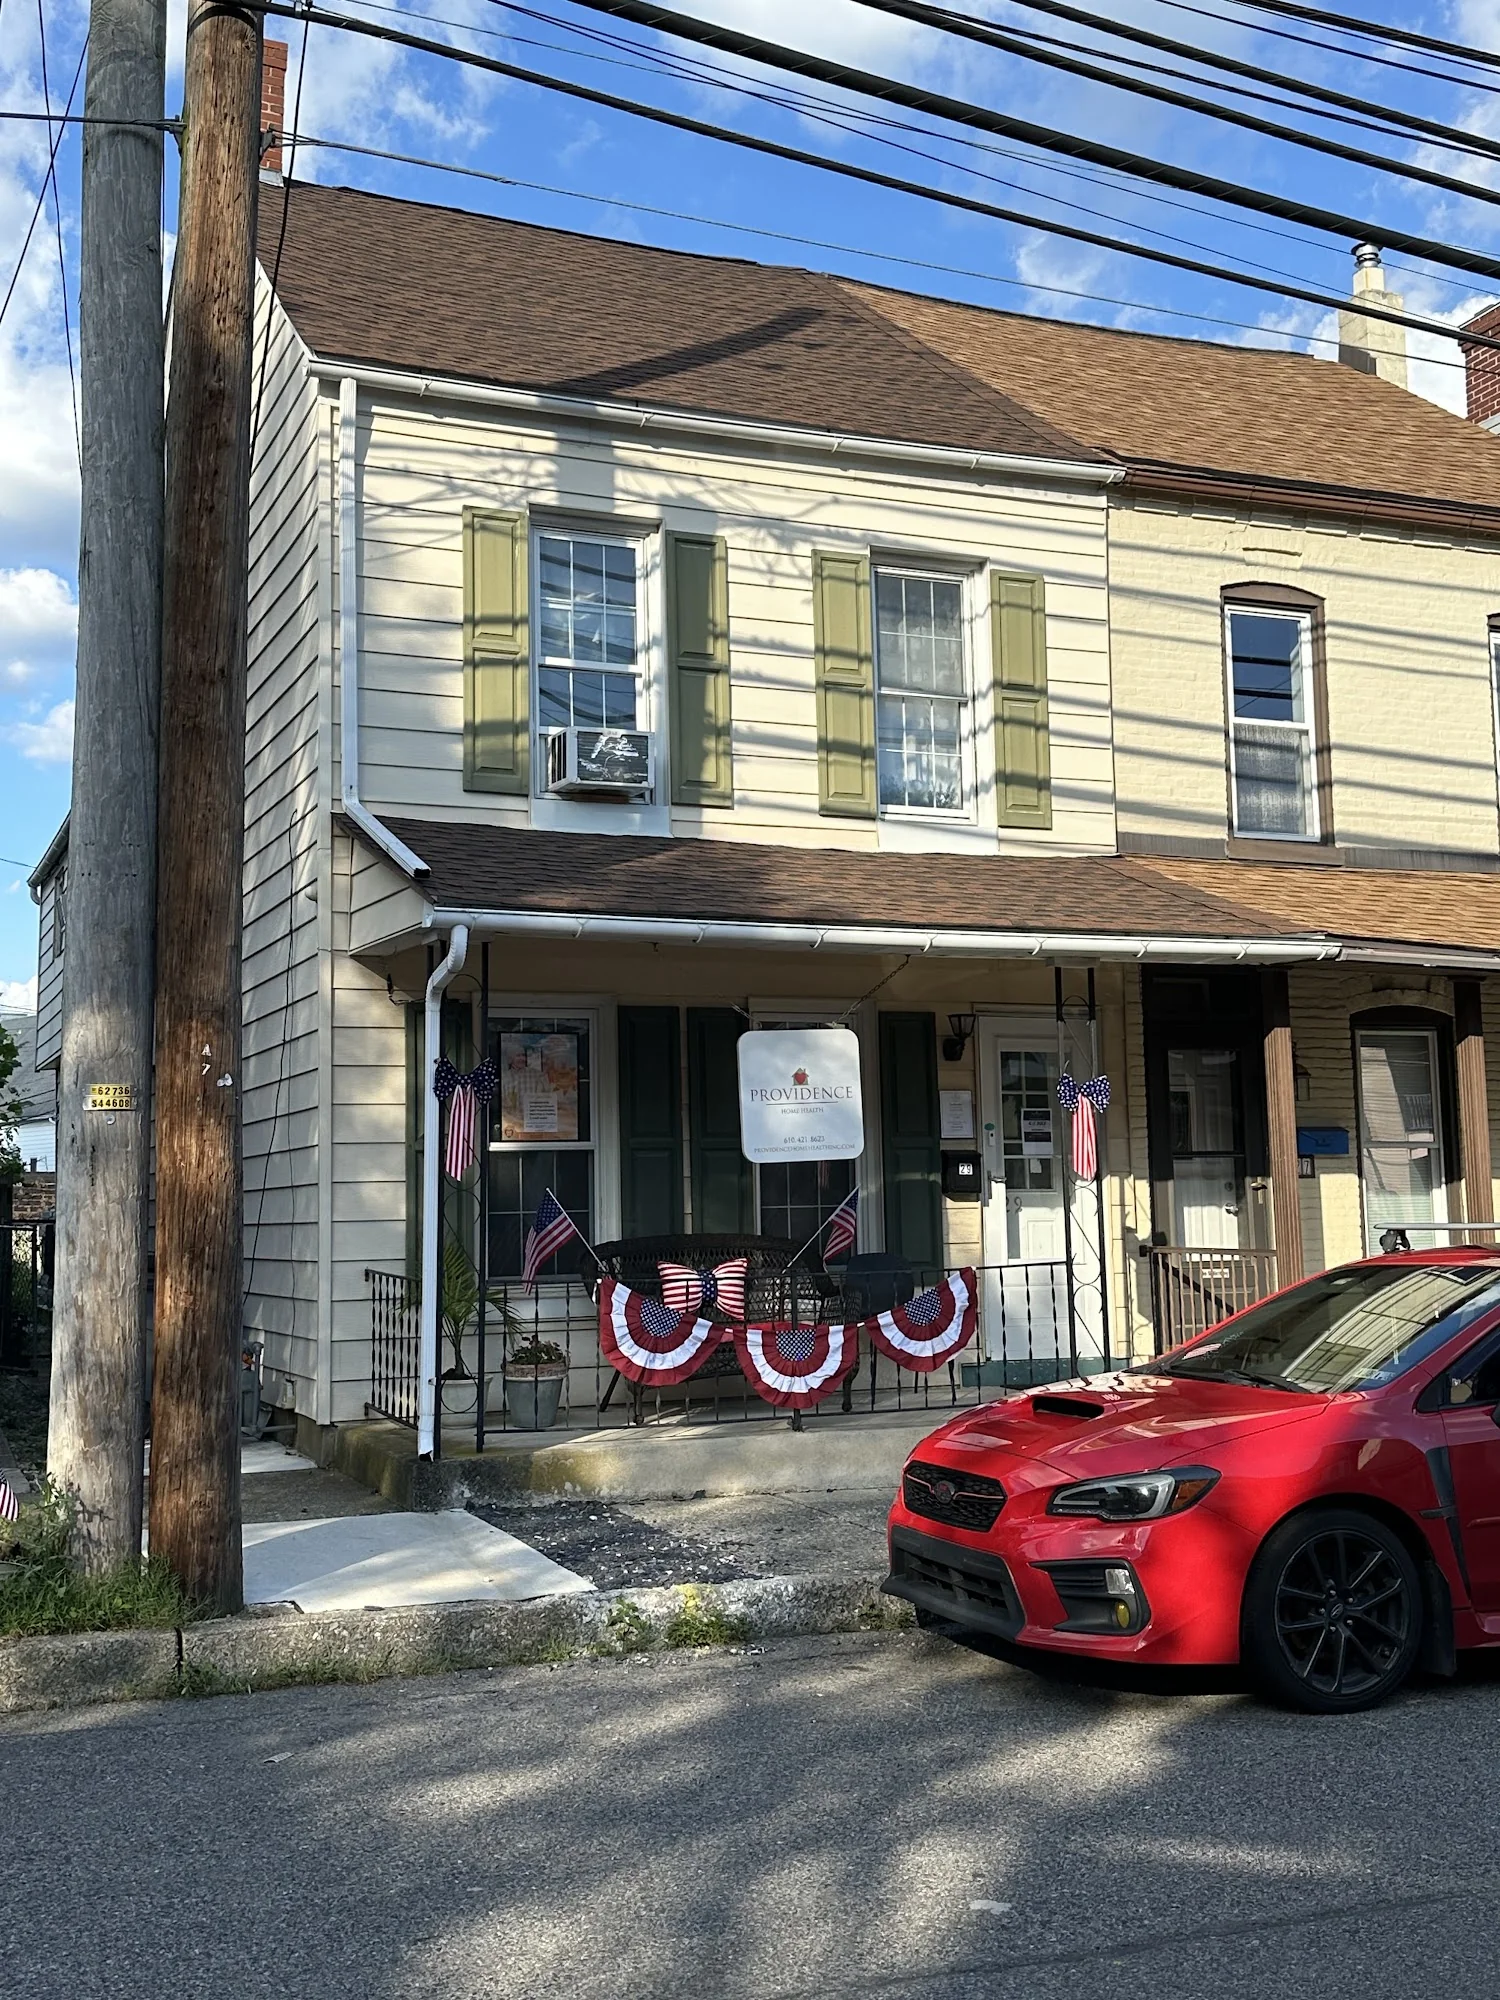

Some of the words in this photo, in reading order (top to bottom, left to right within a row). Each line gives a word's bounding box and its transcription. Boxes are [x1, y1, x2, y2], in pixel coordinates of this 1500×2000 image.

[98, 1086, 130, 1096] 62736
[750, 1086, 853, 1102] PROVIDENCE
[91, 1098, 130, 1108] S44608
[781, 1107, 799, 1115] HOME
[801, 1106, 824, 1114] HEALTH
[960, 1164, 971, 1174] 29
